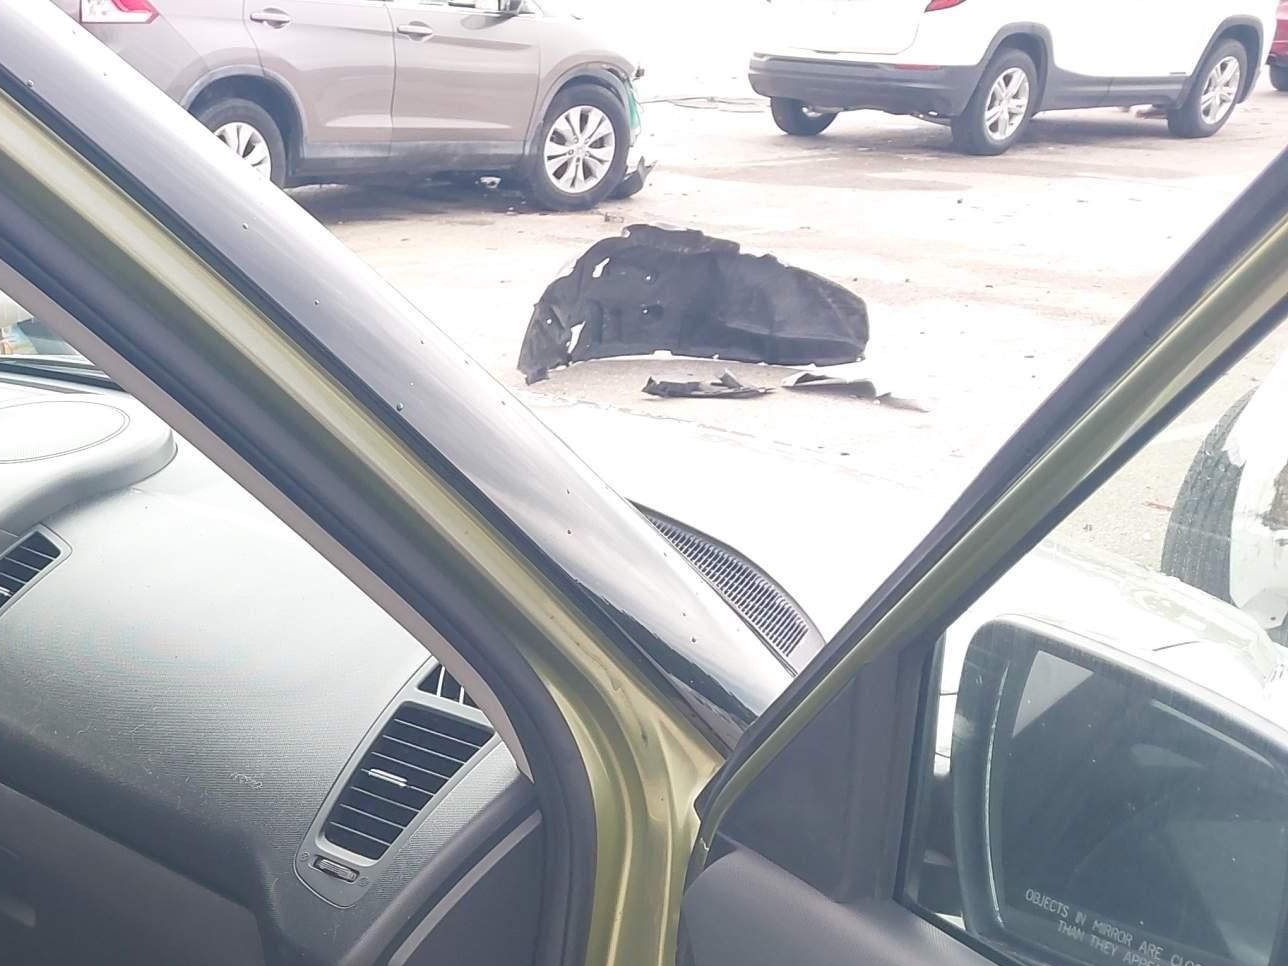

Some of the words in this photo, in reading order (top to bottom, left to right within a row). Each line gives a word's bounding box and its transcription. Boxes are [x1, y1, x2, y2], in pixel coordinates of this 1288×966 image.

[1024, 888, 1070, 918] OBJECTS
[1074, 911, 1087, 926] IN
[1091, 919, 1133, 947] MIRROR
[1138, 940, 1164, 961] ARE
[1057, 919, 1085, 941] THAN
[1090, 934, 1118, 958] THEY
